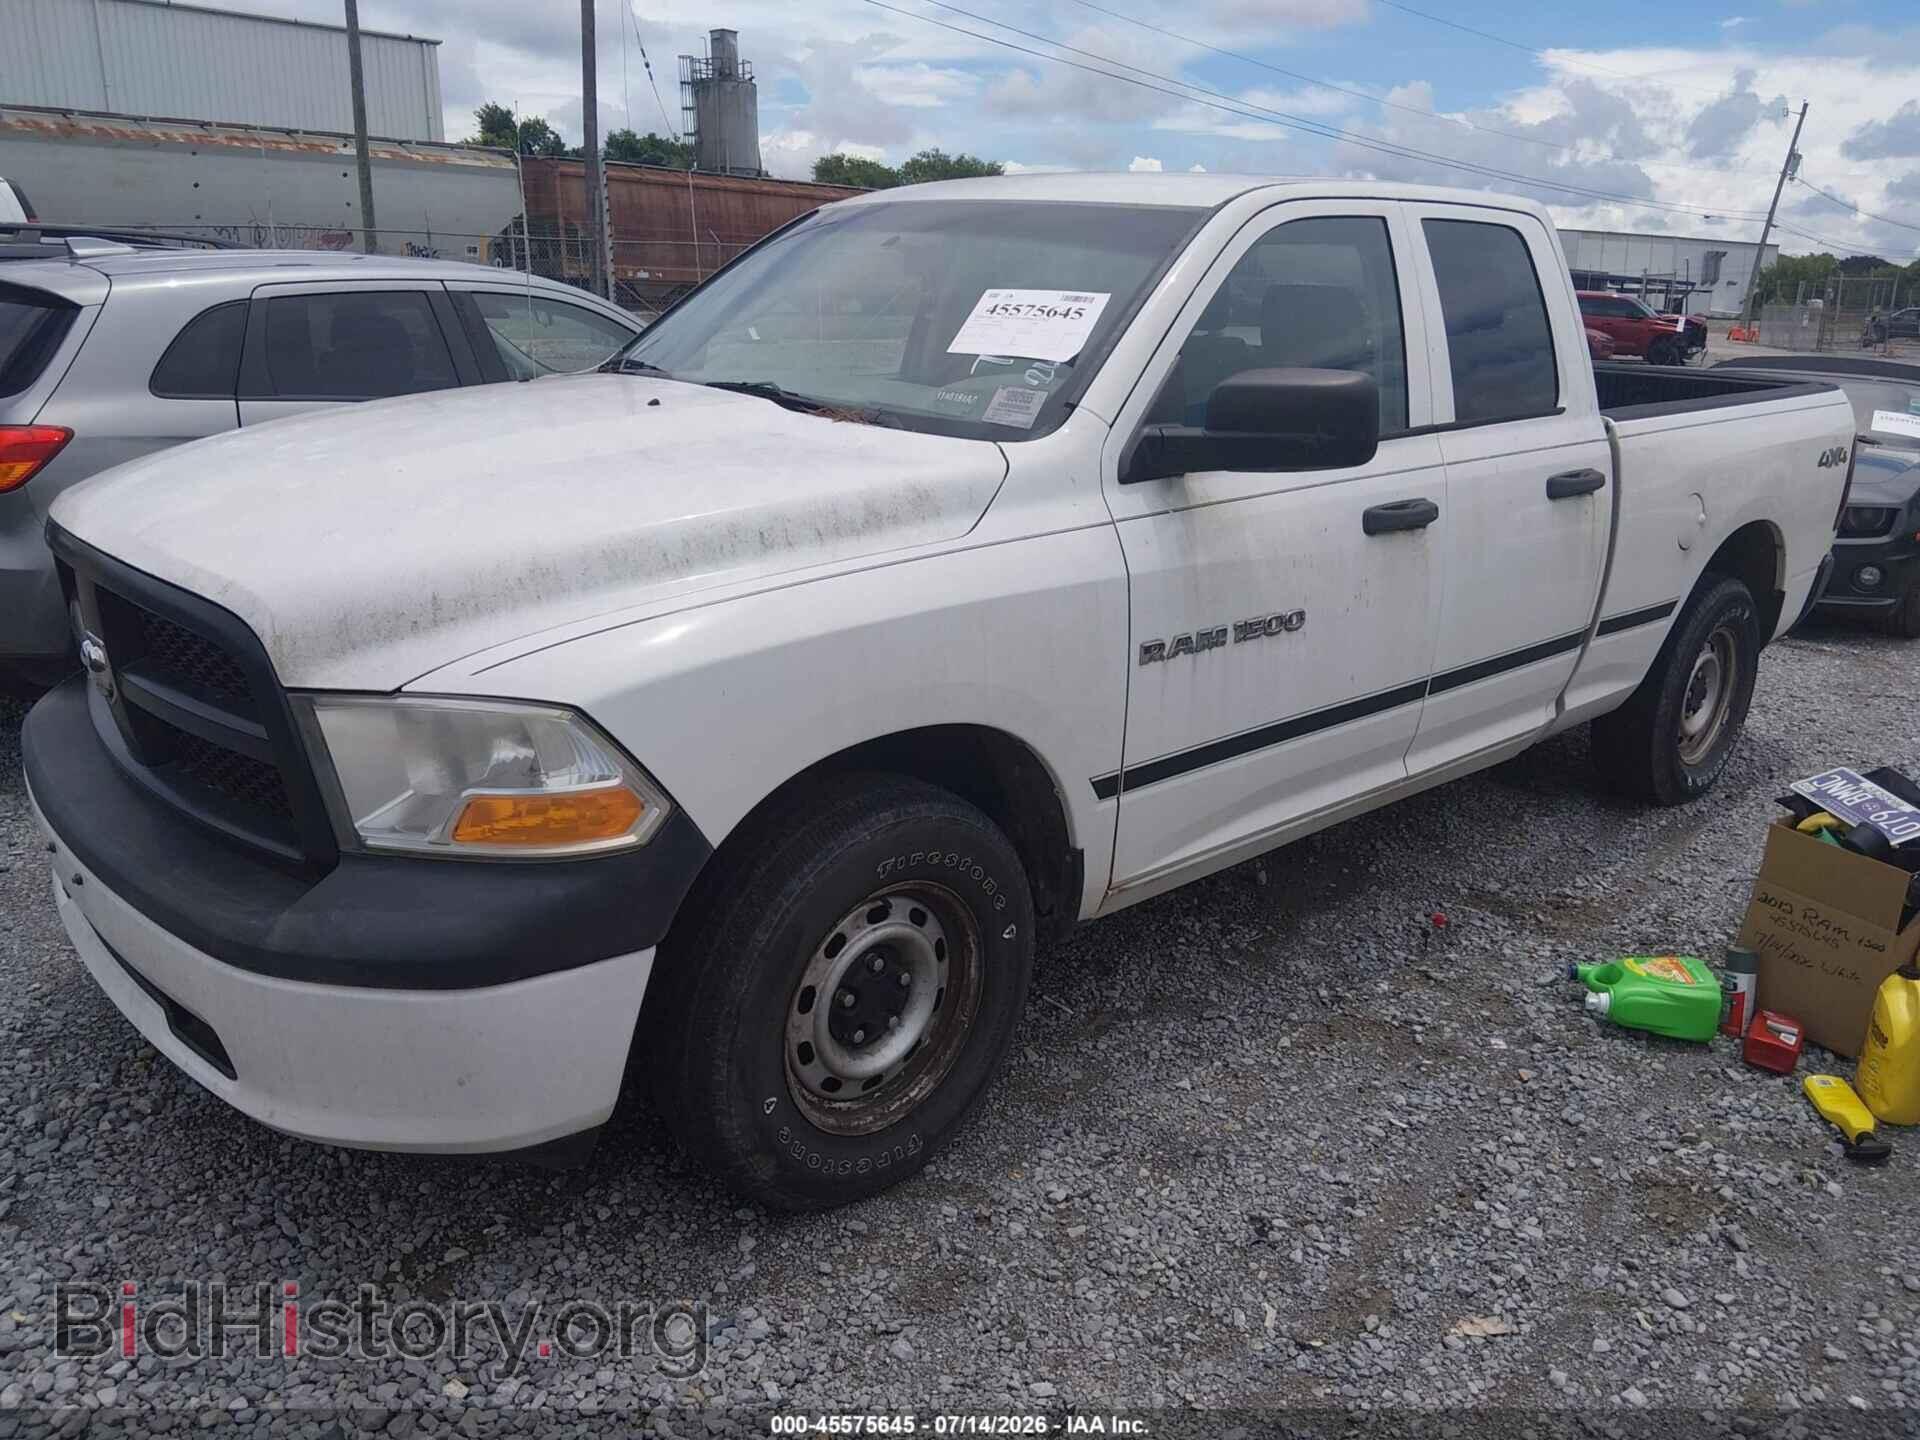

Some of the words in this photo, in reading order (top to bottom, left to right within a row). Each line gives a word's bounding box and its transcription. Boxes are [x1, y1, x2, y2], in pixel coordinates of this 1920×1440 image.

[986, 303, 1087, 320] 45575645
[1139, 626, 1228, 666] RAM
[1233, 608, 1306, 645] 1500
[1812, 774, 1873, 806] BMNC
[876, 850, 1008, 911] Firestone
[1757, 892, 1793, 914] 2012
[778, 1126, 923, 1175] Firestone
